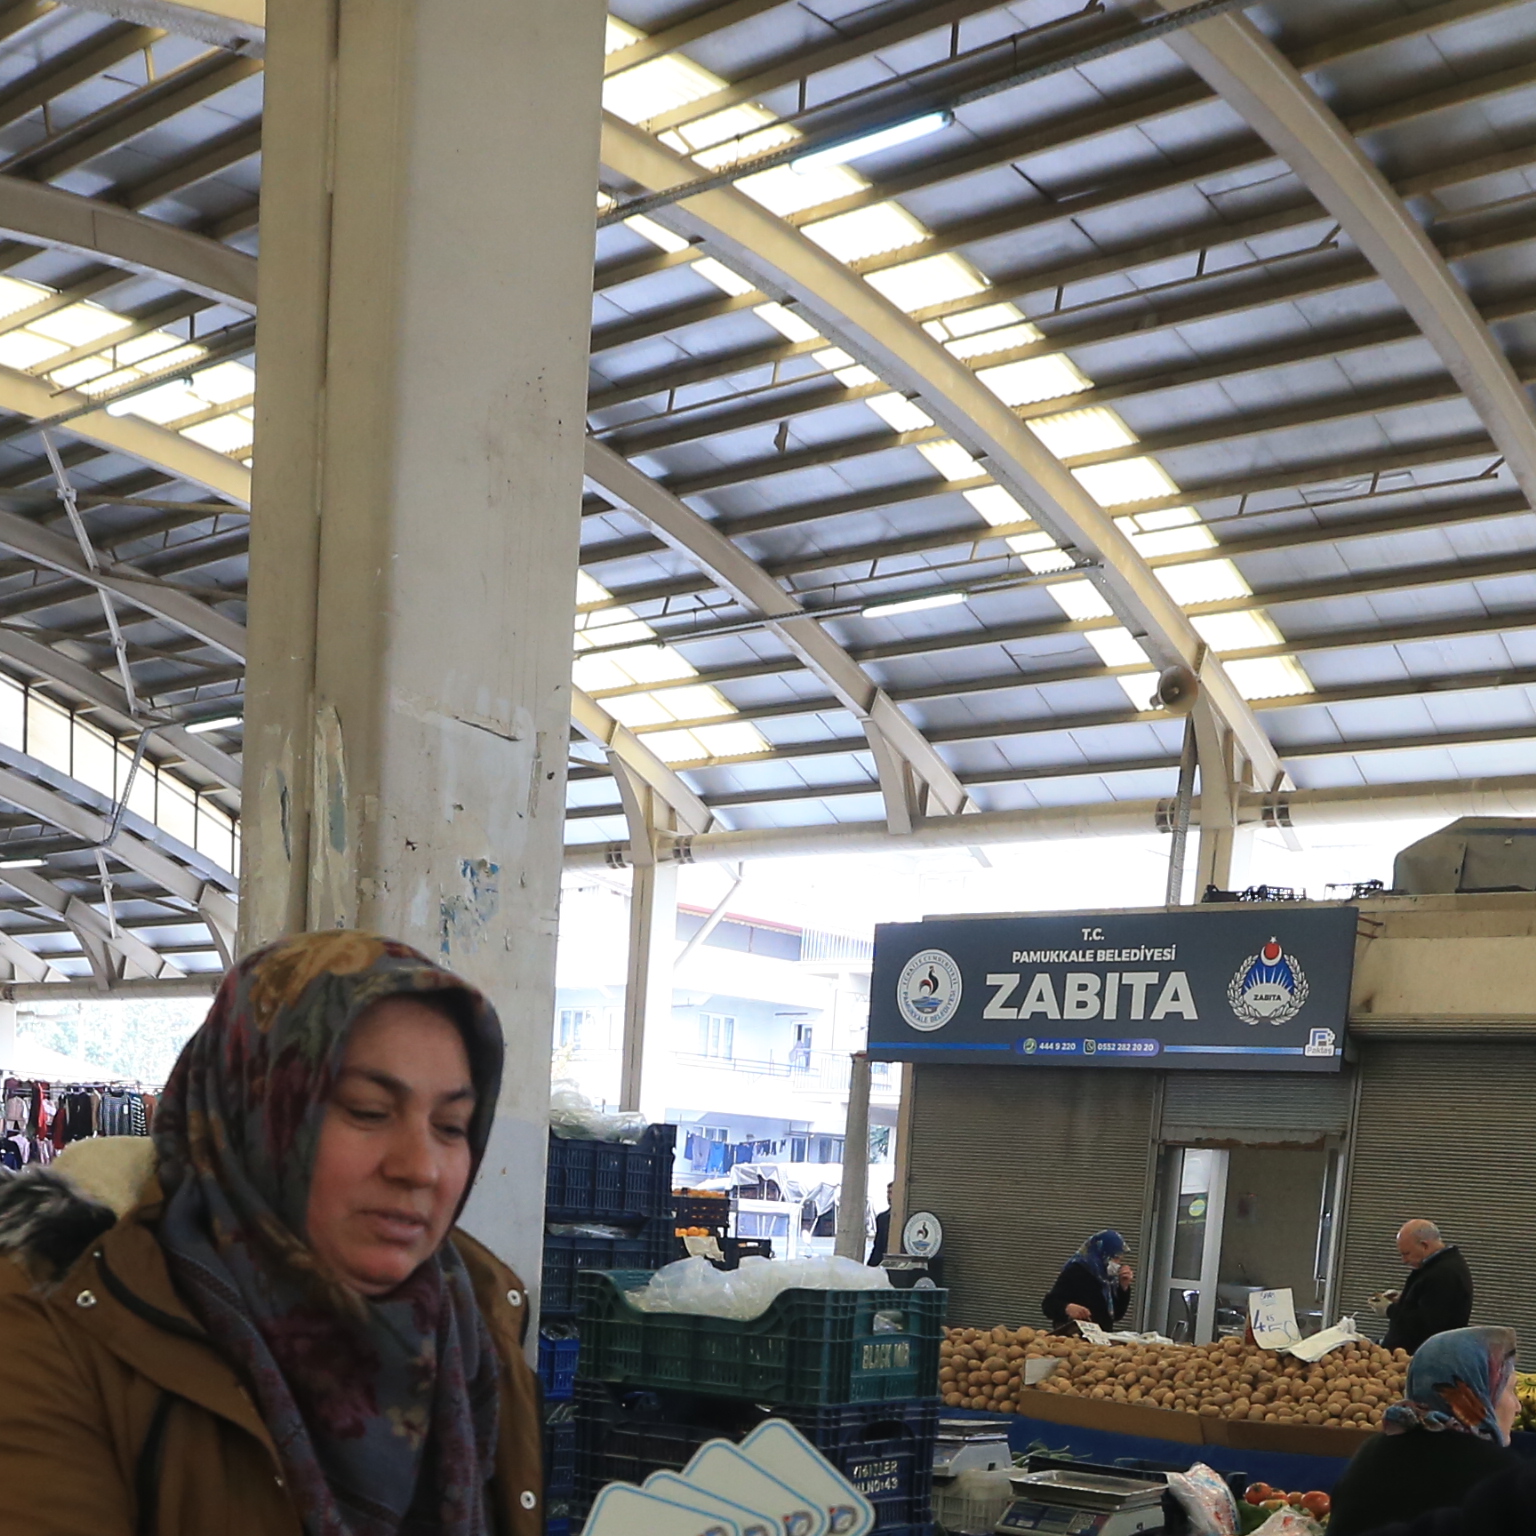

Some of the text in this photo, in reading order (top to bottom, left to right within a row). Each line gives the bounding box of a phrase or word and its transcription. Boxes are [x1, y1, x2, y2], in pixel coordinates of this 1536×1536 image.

[1081, 927, 1105, 941] T.C.
[1011, 944, 1177, 963] PAMUKKALE BELEDİYESİ
[982, 971, 1199, 1021] ZABITA
[1253, 993, 1282, 1002] ZABITA
